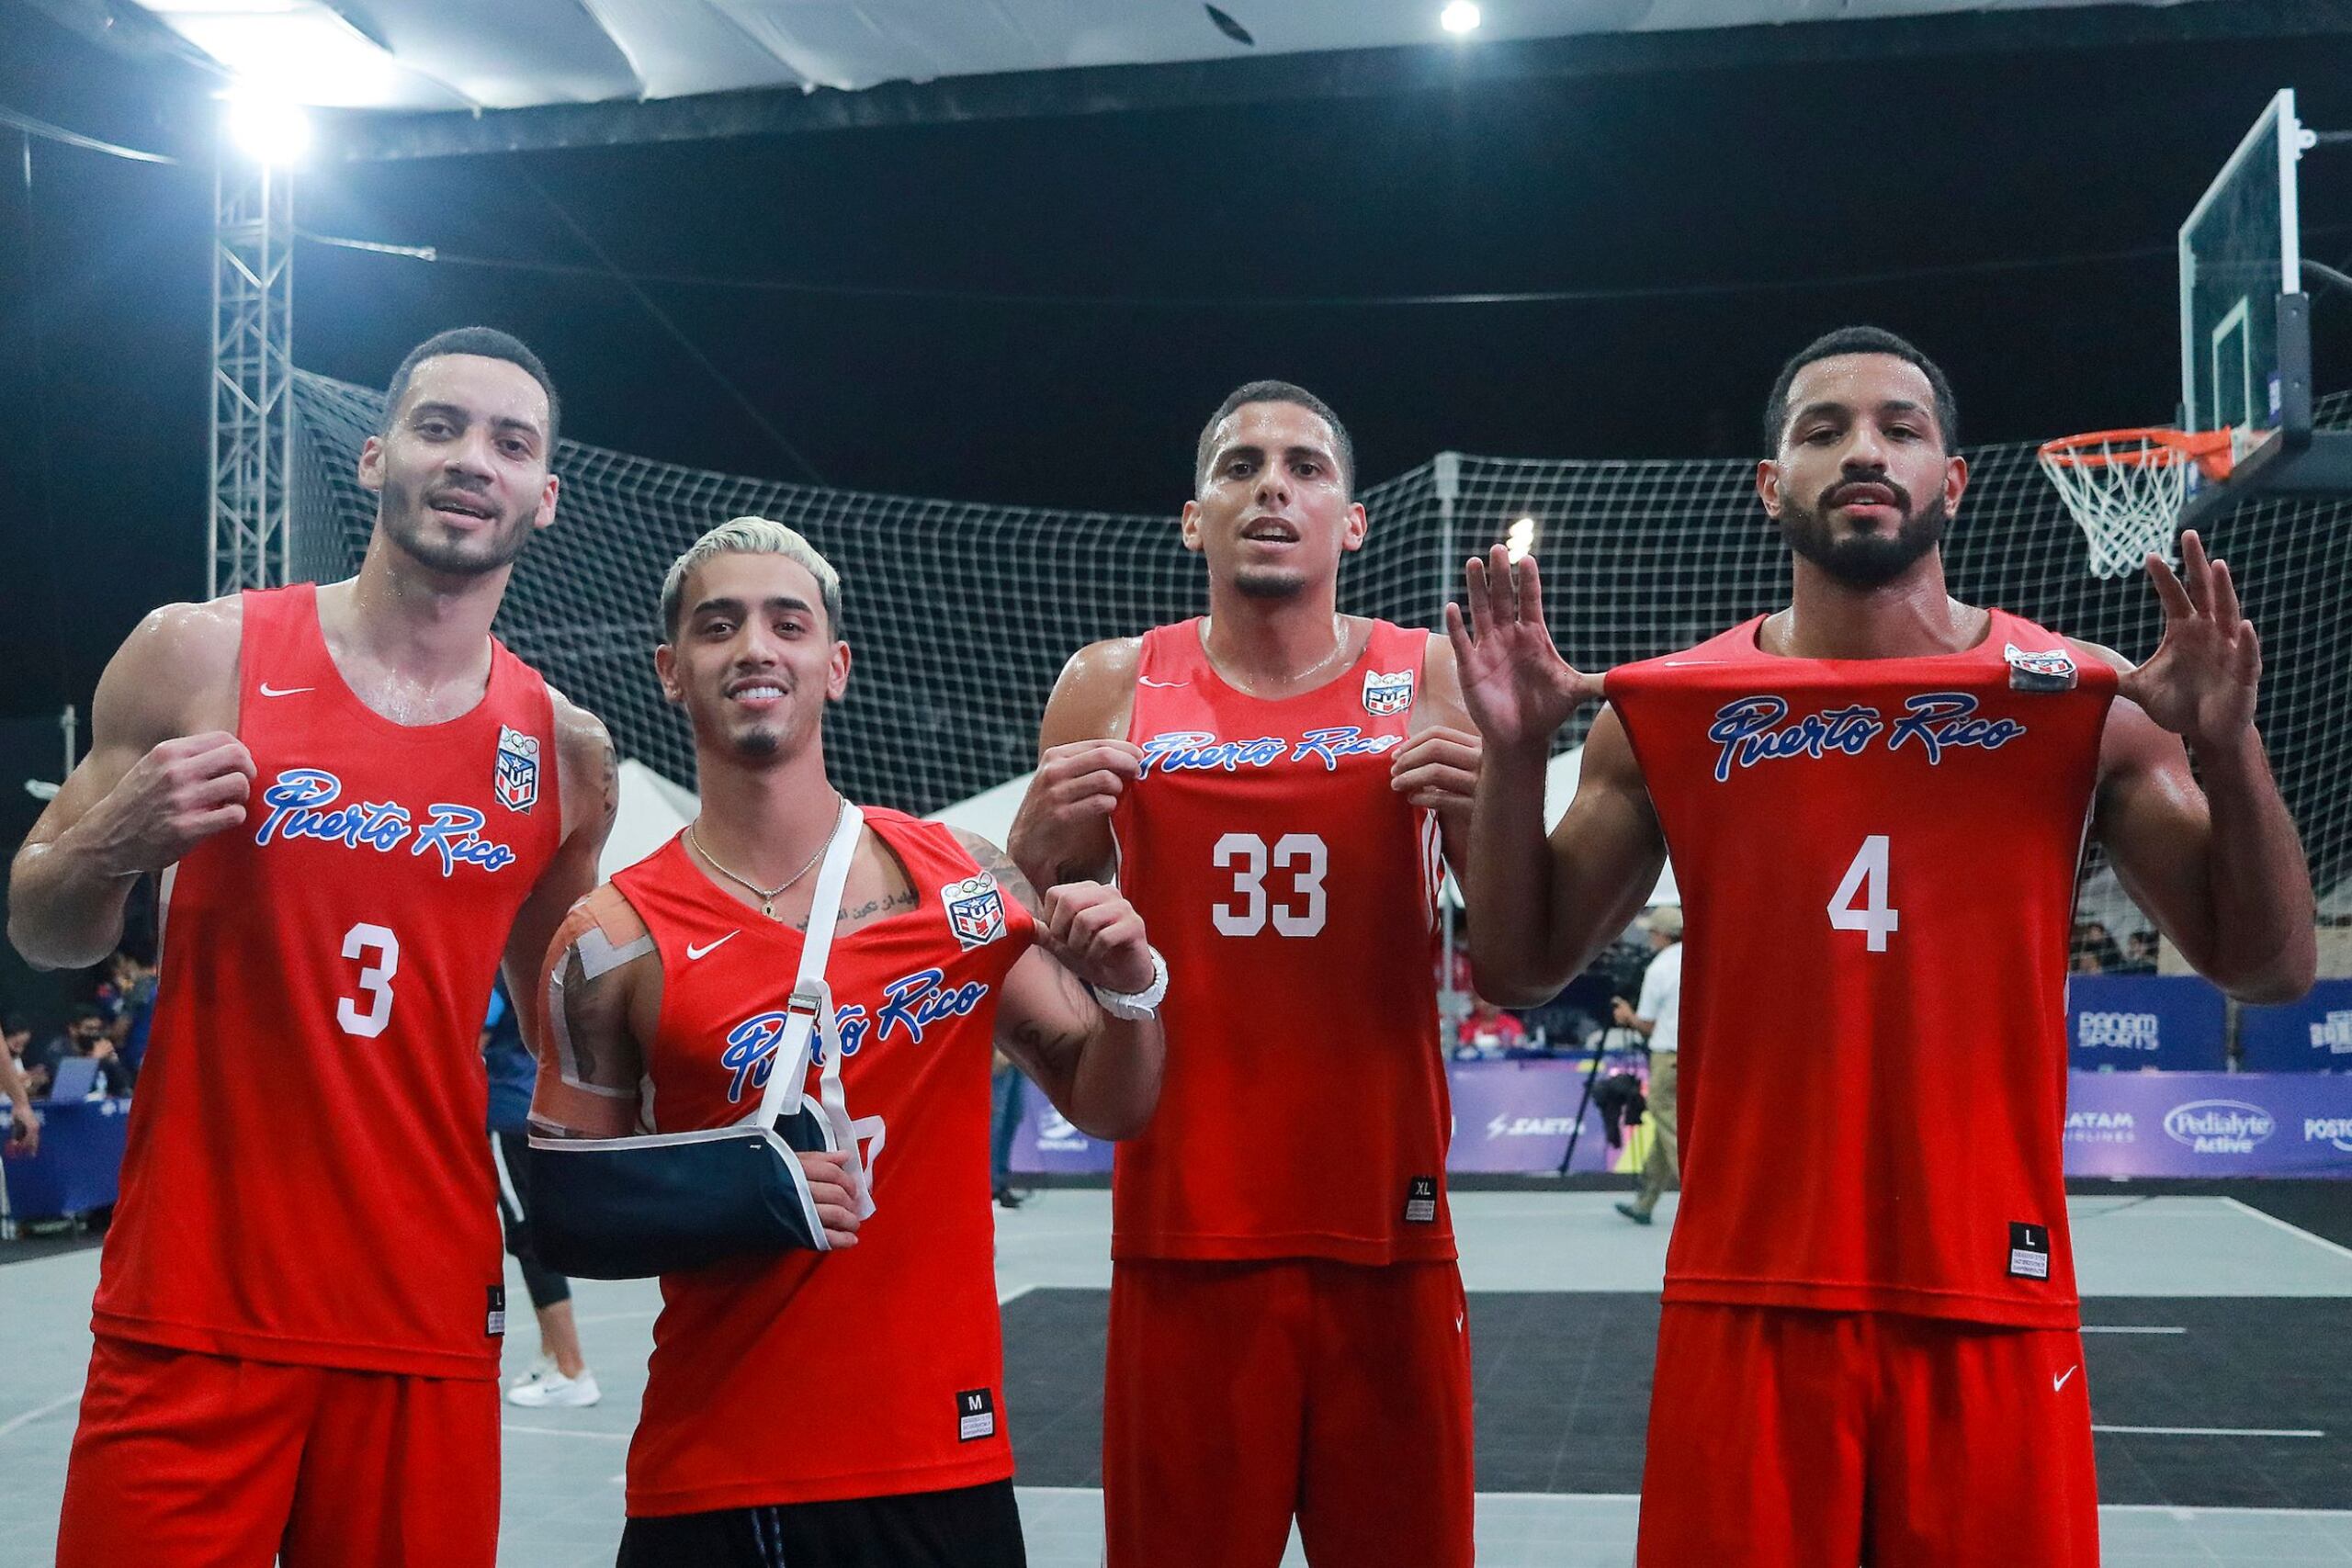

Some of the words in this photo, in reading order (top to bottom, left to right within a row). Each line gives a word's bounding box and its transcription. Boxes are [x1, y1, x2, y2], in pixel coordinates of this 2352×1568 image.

[1138, 731, 1288, 780] Puerto
[1290, 726, 1403, 771] Rico
[1710, 695, 1883, 782] Puerto
[1889, 692, 2027, 765] Rico
[255, 768, 412, 849] Puerto
[411, 803, 516, 877] Rico
[1212, 832, 1329, 937] 33
[1826, 835, 1899, 952] 4
[336, 922, 400, 1039] 3
[877, 967, 989, 1043] Rico
[2064, 1111, 2134, 1129] ATAM
[2178, 1111, 2270, 1139] Pedialyte
[2193, 1136, 2255, 1154] Active
[1416, 1181, 1430, 1195] XL
[2025, 1229, 2036, 1246] L
[967, 1394, 983, 1411] M
